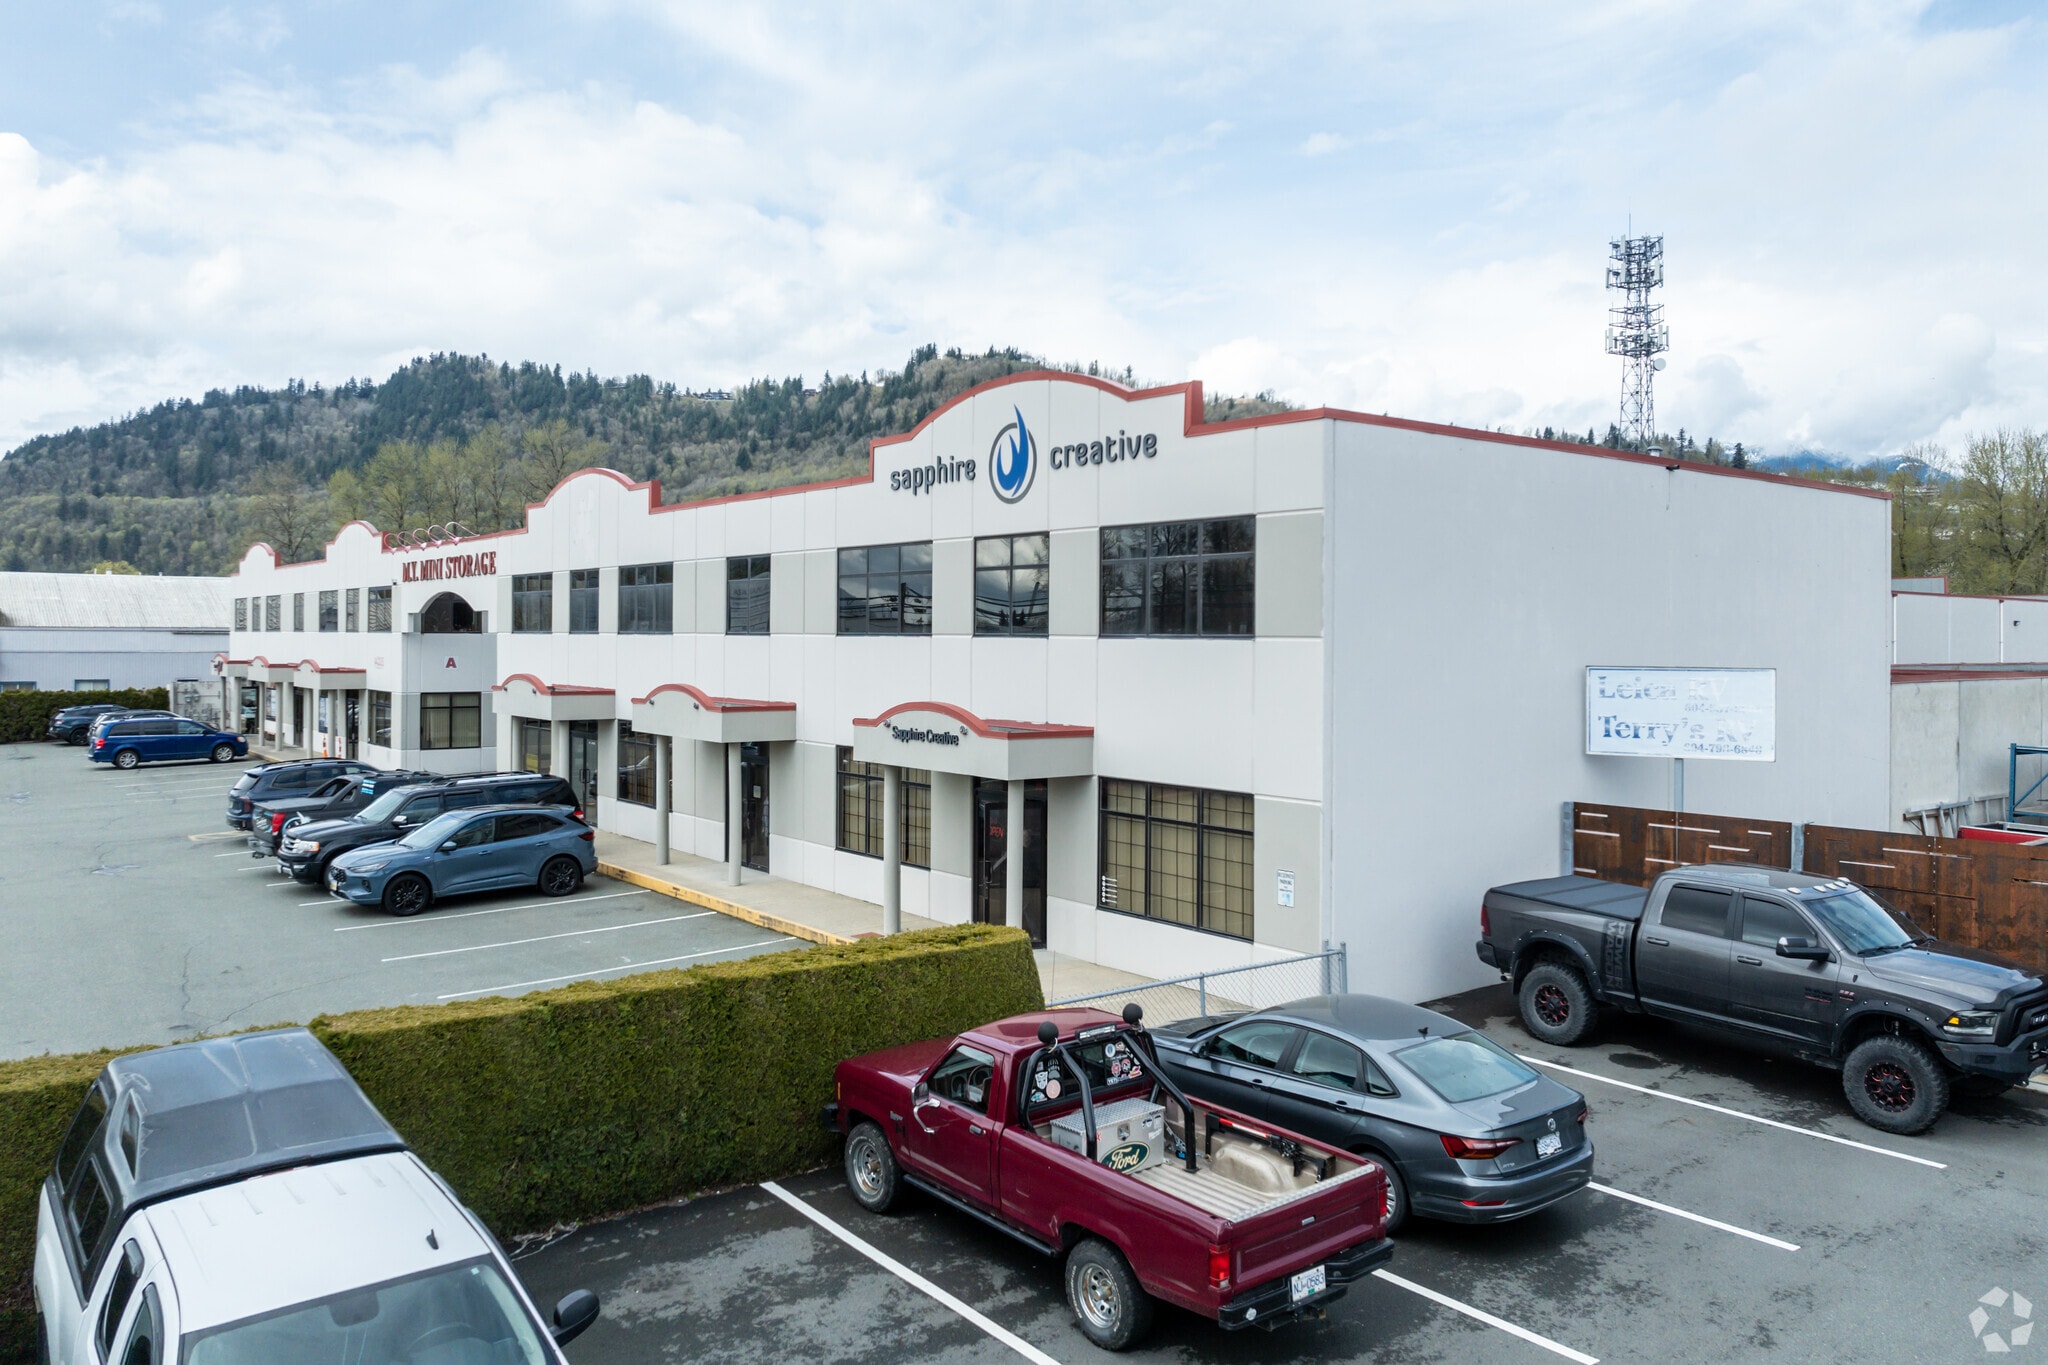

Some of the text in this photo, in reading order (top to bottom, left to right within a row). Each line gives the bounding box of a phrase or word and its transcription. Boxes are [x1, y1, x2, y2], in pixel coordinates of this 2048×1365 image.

[890, 429, 1158, 496] sapphire creative
[420, 558, 444, 582] MINI
[445, 551, 496, 579] STORAGE
[445, 657, 457, 669] A
[892, 725, 959, 746] Sapphire Creative
[1605, 921, 1618, 989] WAGON
[1614, 922, 1627, 990] POWER
[1109, 1146, 1140, 1170] Ford
